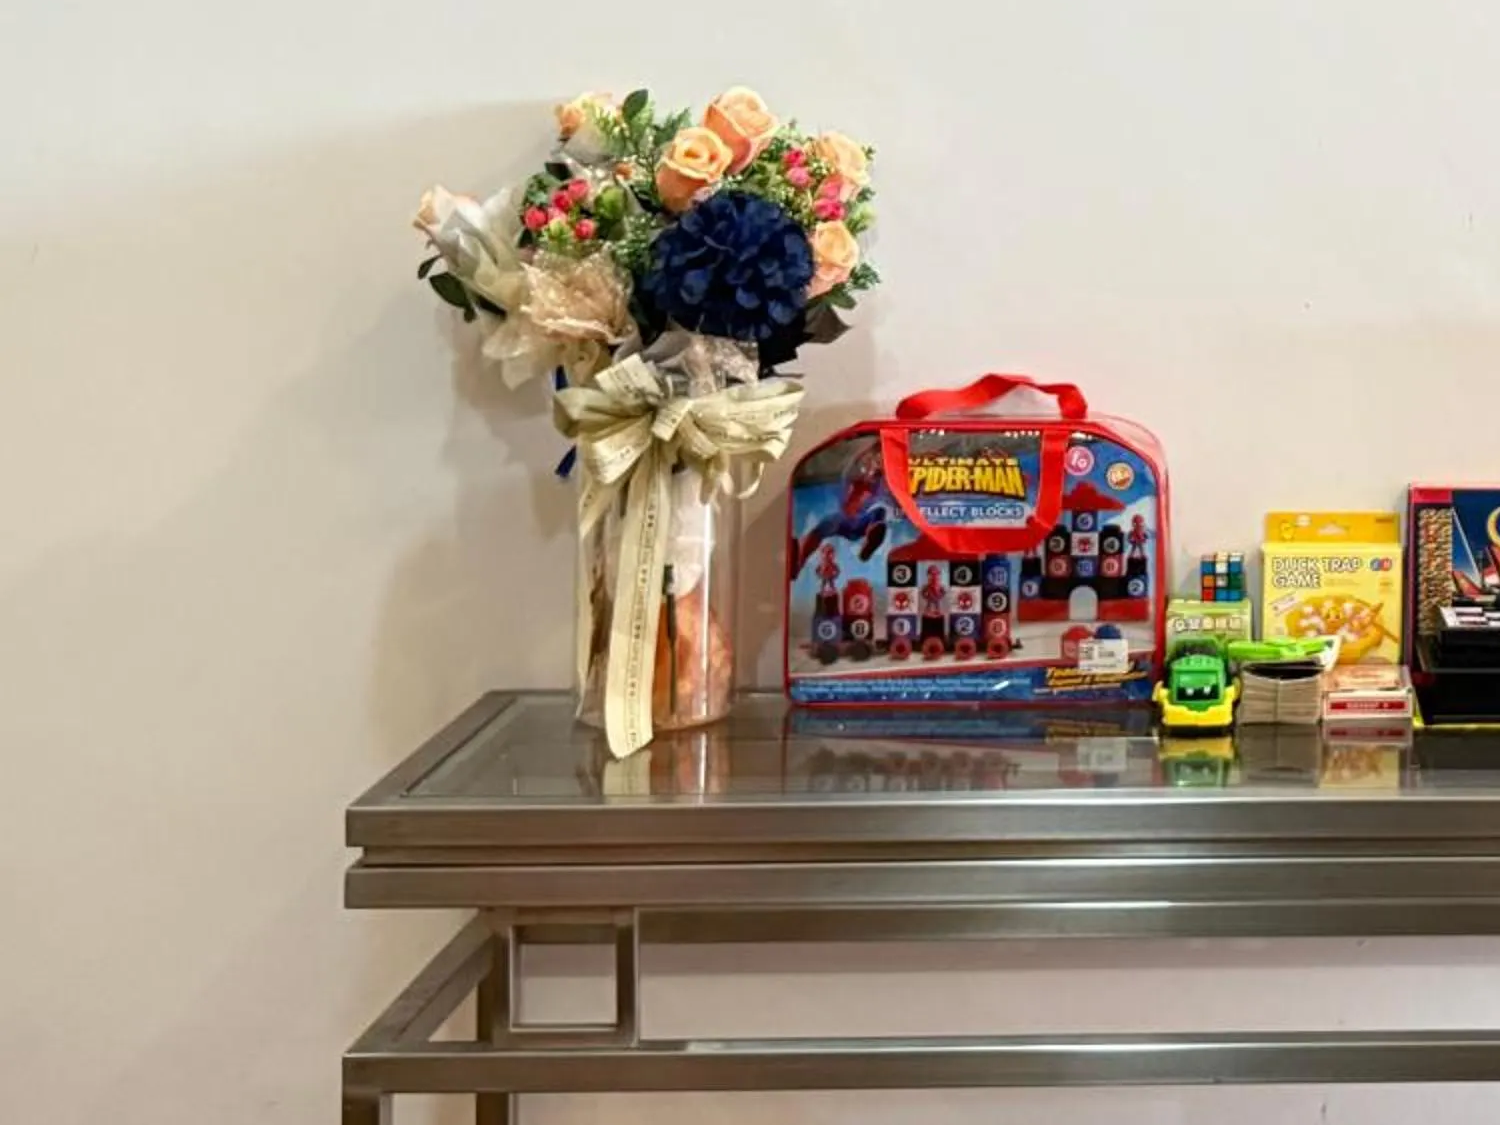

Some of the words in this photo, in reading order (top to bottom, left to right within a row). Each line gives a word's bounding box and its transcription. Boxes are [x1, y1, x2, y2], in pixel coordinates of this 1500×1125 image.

[907, 467, 1025, 497] PIDER-MAN
[971, 506, 1024, 518] BLOCKS
[1271, 556, 1319, 573] DUCK
[1321, 556, 1362, 573] TRAP
[1272, 572, 1321, 588] GAME
